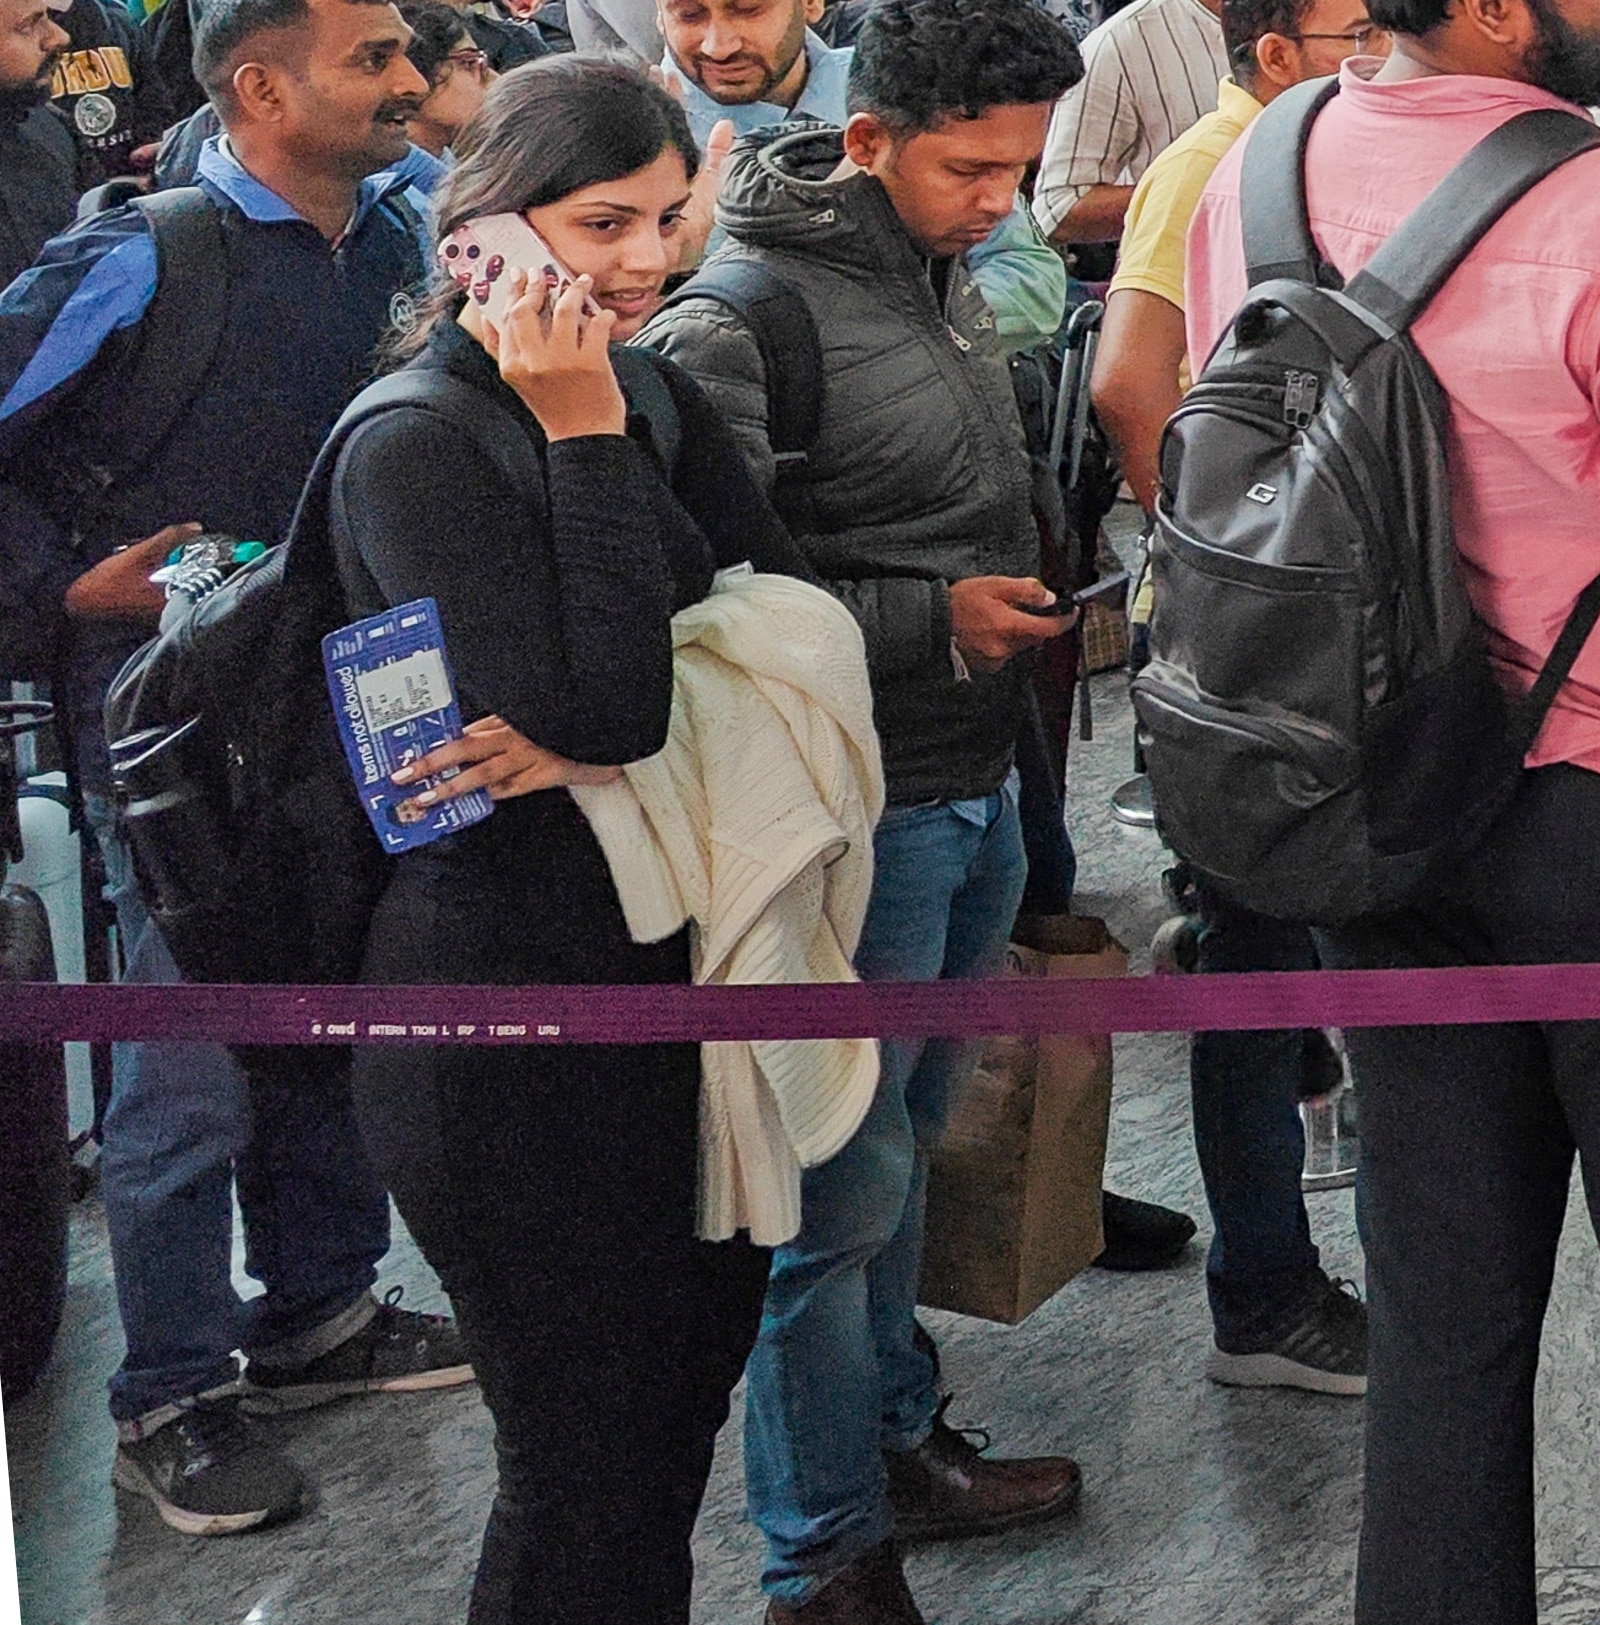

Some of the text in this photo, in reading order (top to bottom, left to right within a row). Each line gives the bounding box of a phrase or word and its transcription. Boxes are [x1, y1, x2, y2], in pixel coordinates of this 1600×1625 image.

[334, 666, 361, 720] allowed
[351, 717, 369, 744] not
[358, 745, 380, 786] Items
